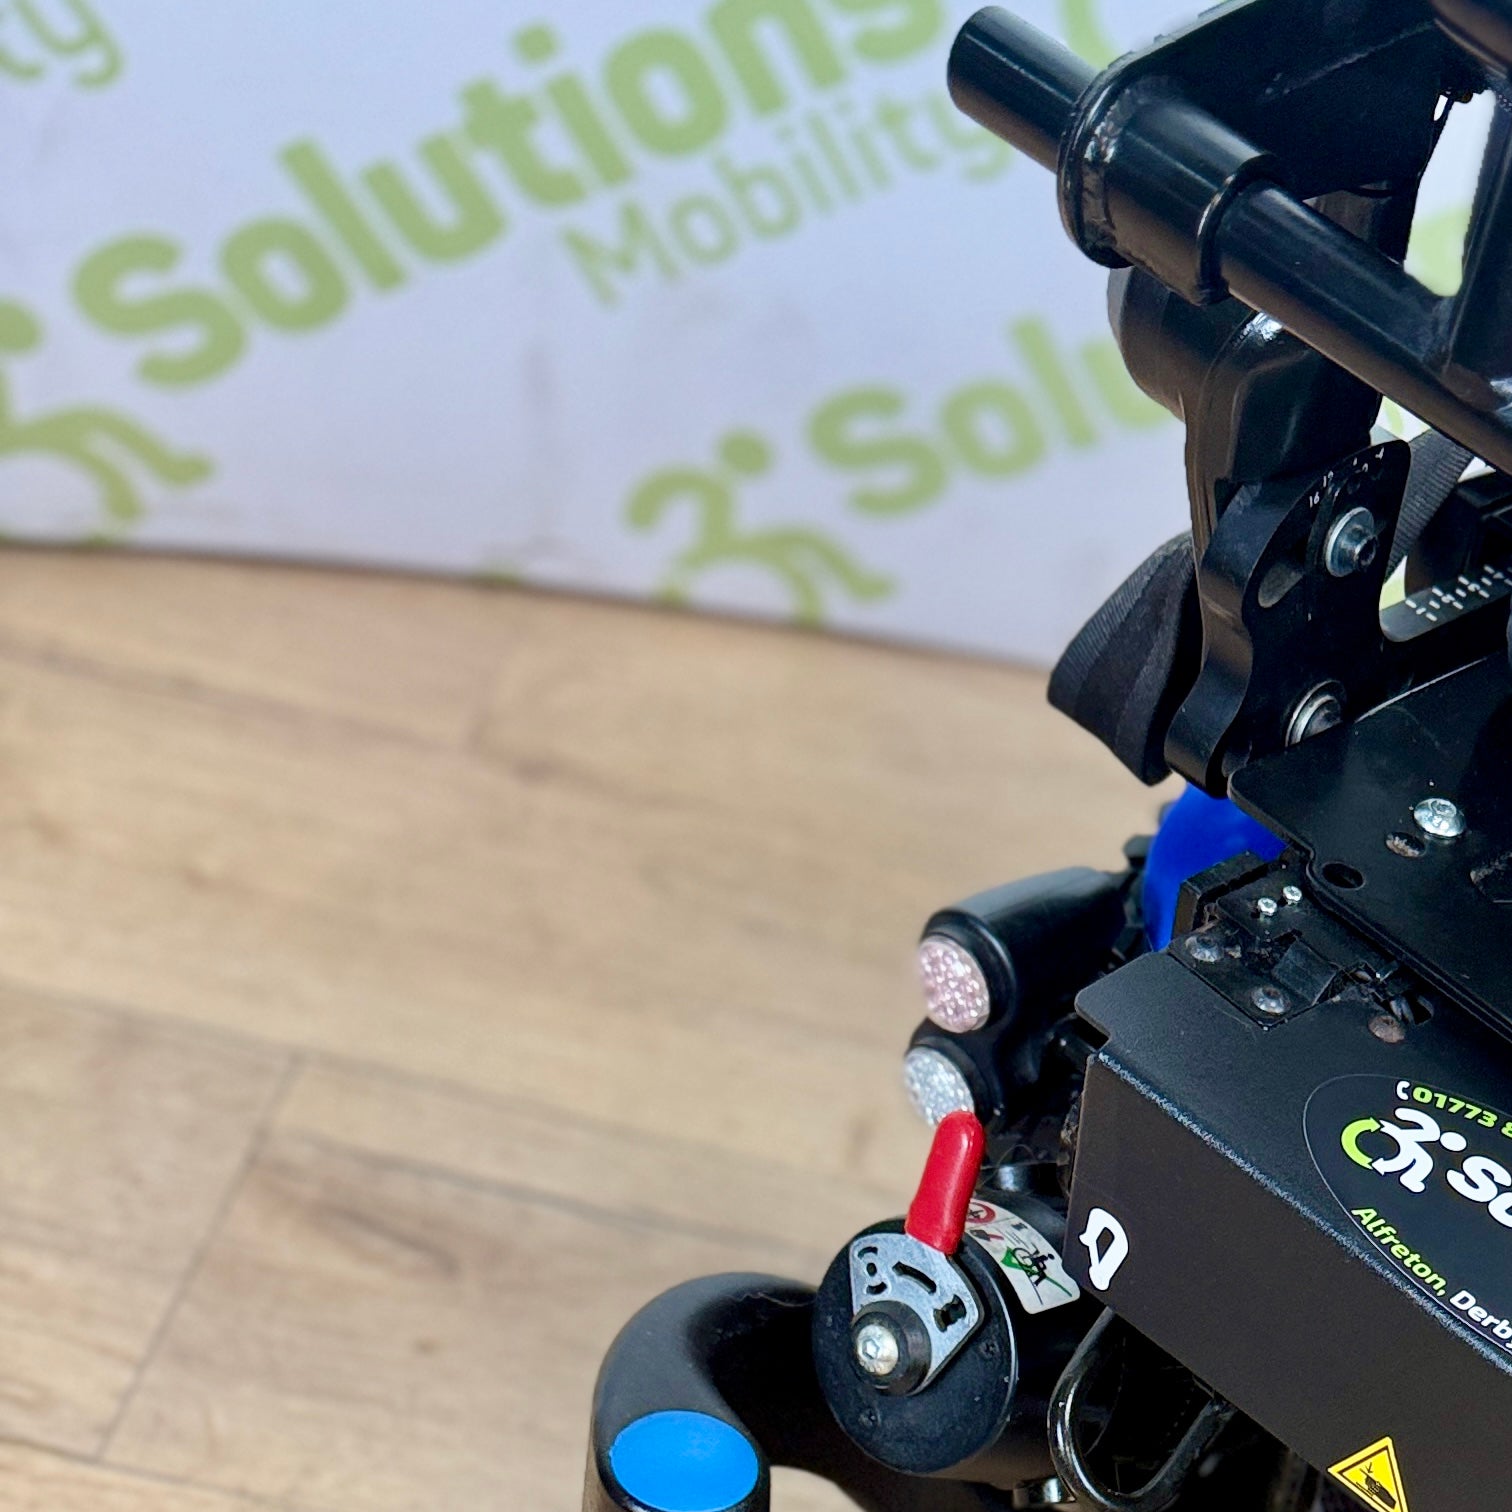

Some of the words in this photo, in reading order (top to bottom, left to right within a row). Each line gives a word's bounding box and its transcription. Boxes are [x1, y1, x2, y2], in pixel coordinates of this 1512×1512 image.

[562, 86, 1013, 307] Mobility
[1412, 1086, 1498, 1129] 01773
[1351, 1206, 1448, 1297] Alfreton,
